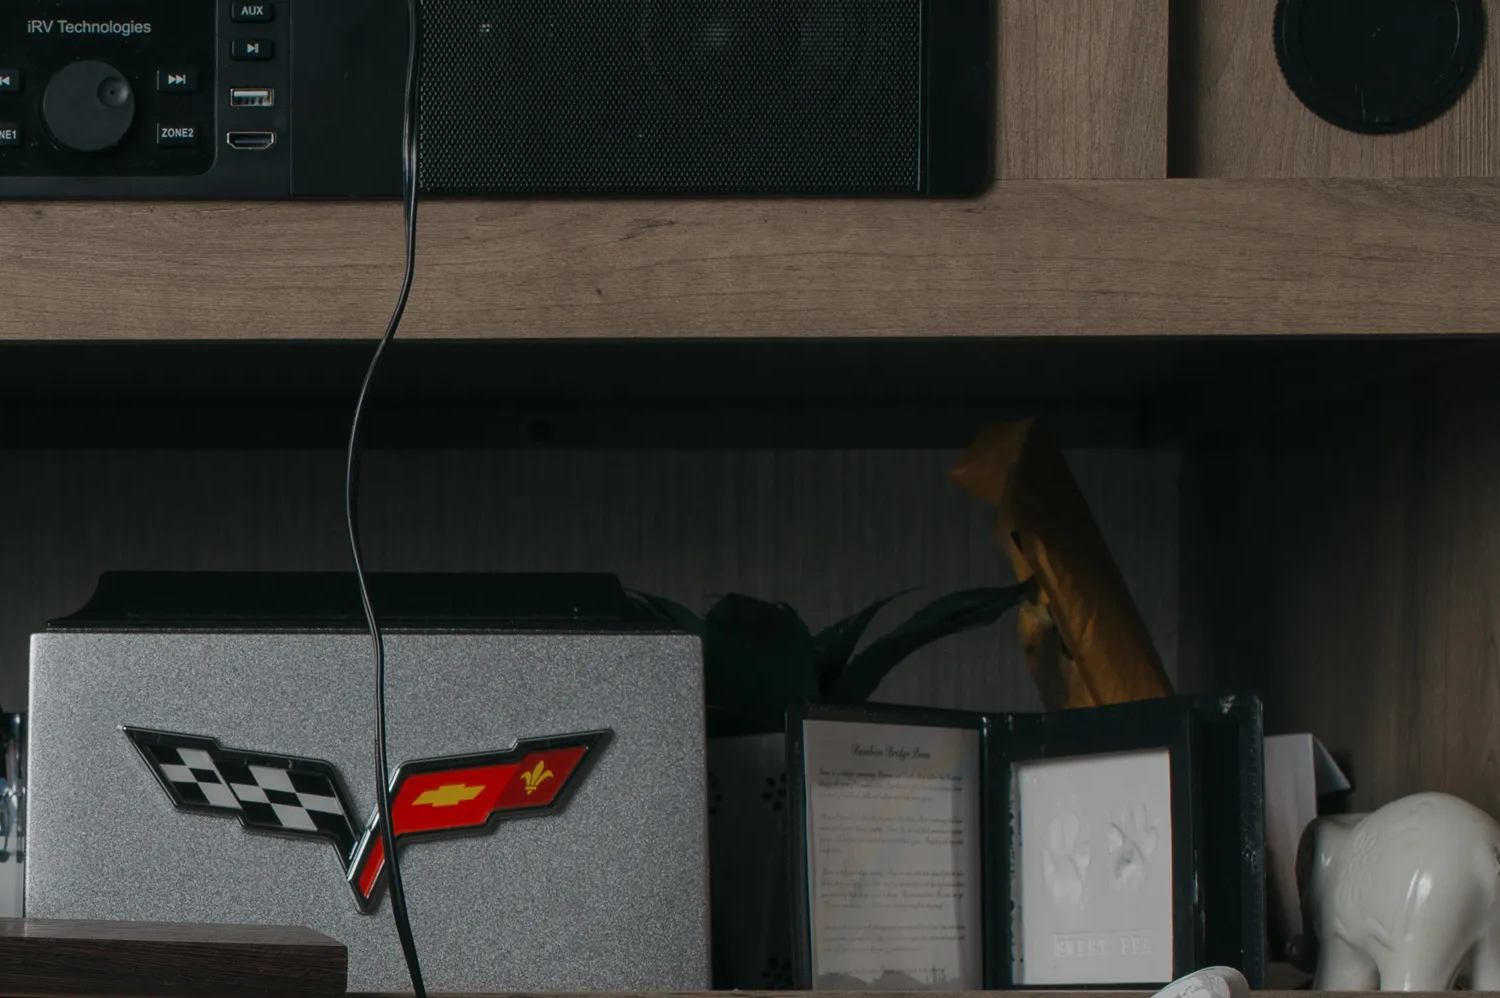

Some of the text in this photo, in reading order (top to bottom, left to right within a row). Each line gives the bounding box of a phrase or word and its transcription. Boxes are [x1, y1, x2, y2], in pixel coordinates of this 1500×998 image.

[241, 5, 264, 16] AUX
[27, 20, 152, 36] iRV Technologies
[161, 127, 194, 139] ZONE2
